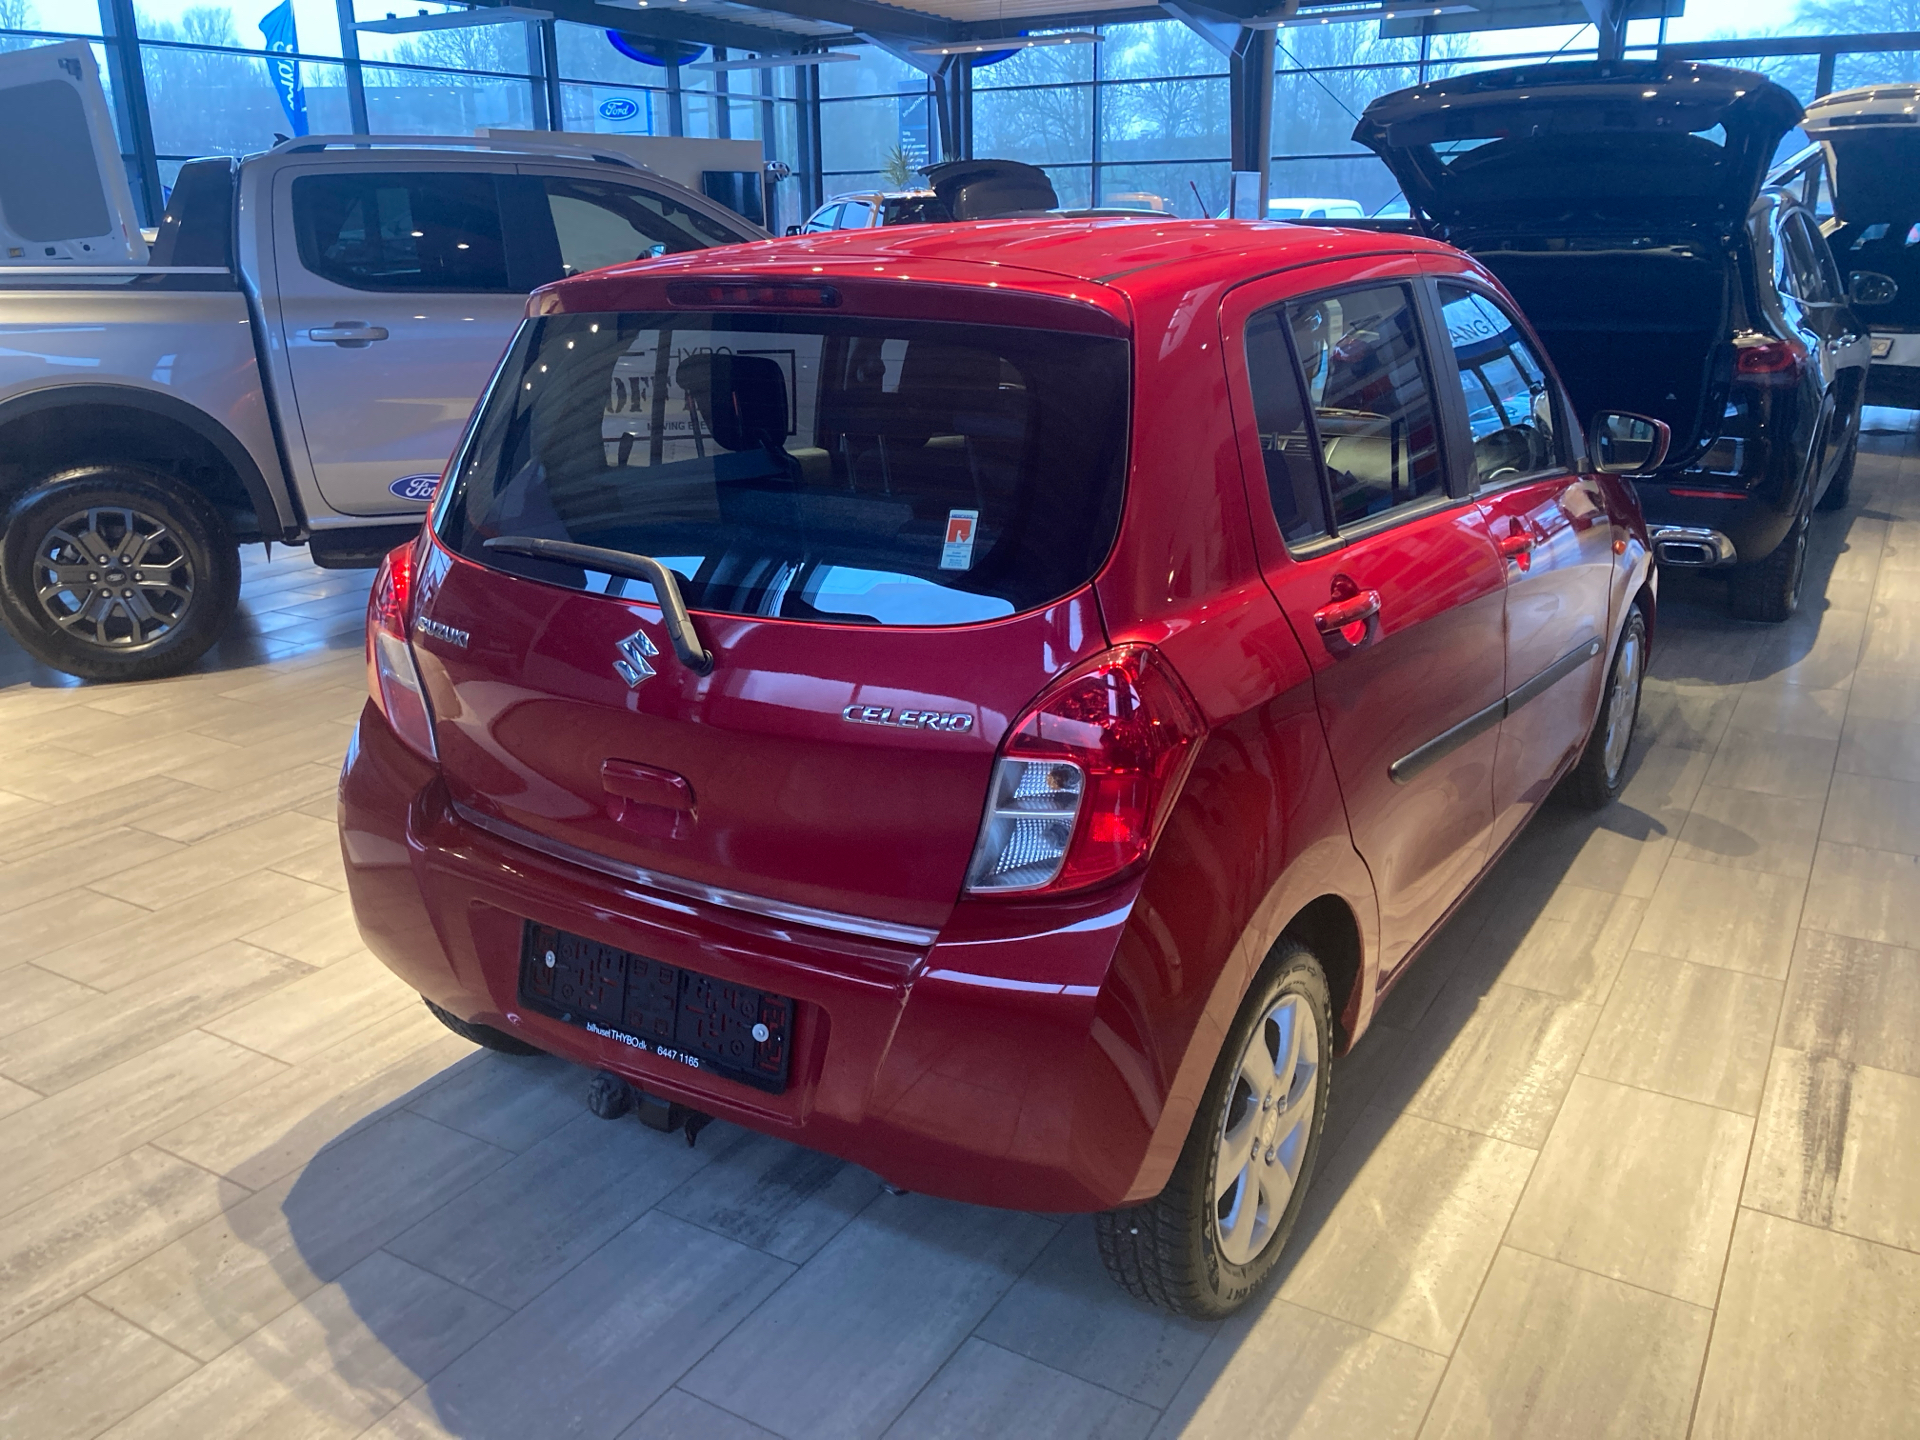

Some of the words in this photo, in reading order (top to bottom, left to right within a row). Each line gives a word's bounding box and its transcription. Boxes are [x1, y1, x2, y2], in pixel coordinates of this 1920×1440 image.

[605, 102, 630, 116] Ford
[405, 478, 440, 497] For
[417, 616, 470, 649] SUZUKI
[842, 703, 974, 733] CELERIO
[657, 1045, 678, 1060] 6447
[679, 1053, 699, 1068] 1165
